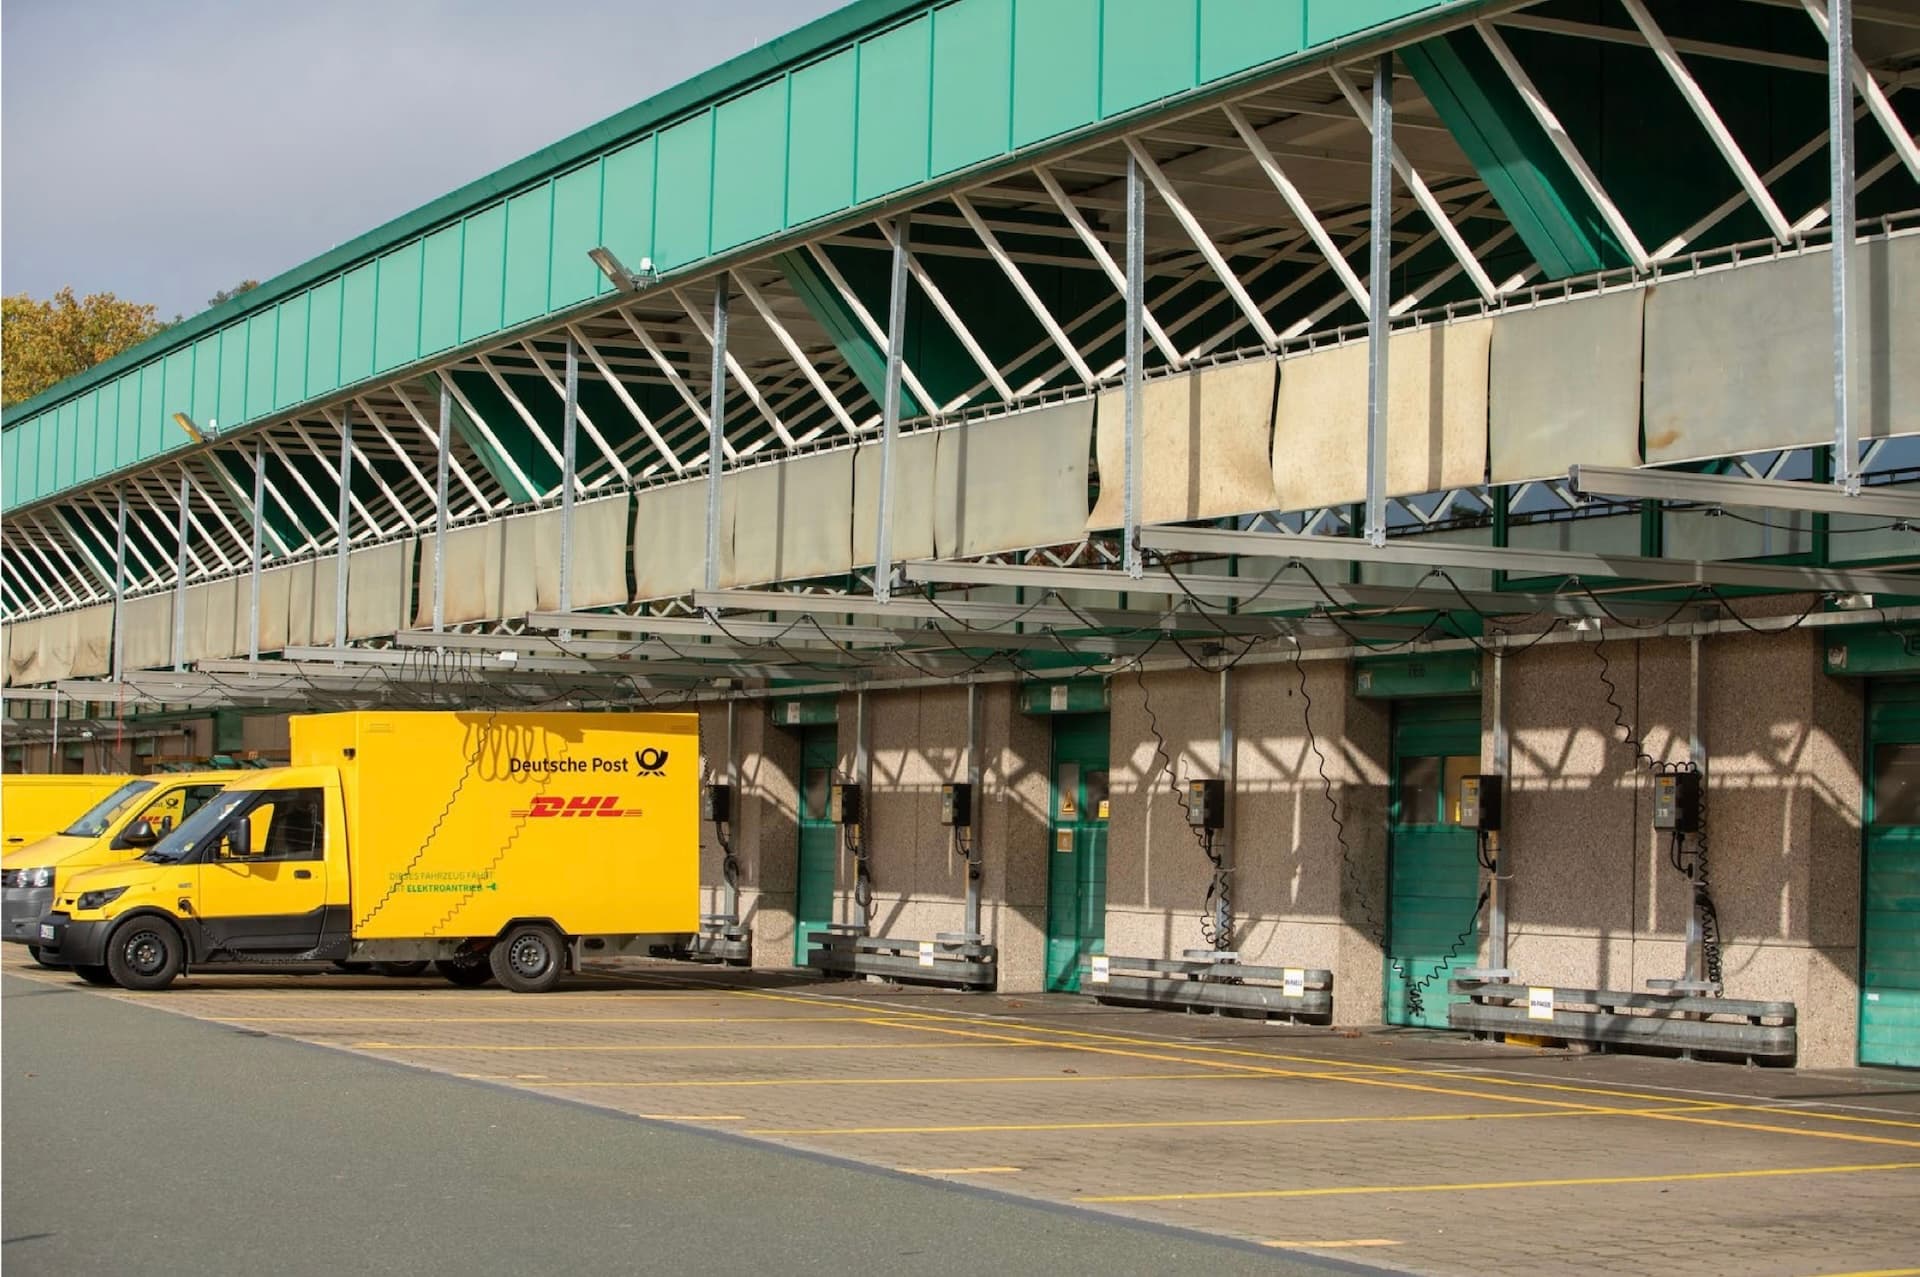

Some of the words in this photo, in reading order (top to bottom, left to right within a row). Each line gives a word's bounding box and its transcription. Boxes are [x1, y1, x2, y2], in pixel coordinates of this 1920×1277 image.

[510, 756, 587, 773] Deutsche
[592, 757, 629, 773] Post
[529, 796, 625, 817] DHL
[406, 883, 482, 893] ELEKTROANTRIEB
